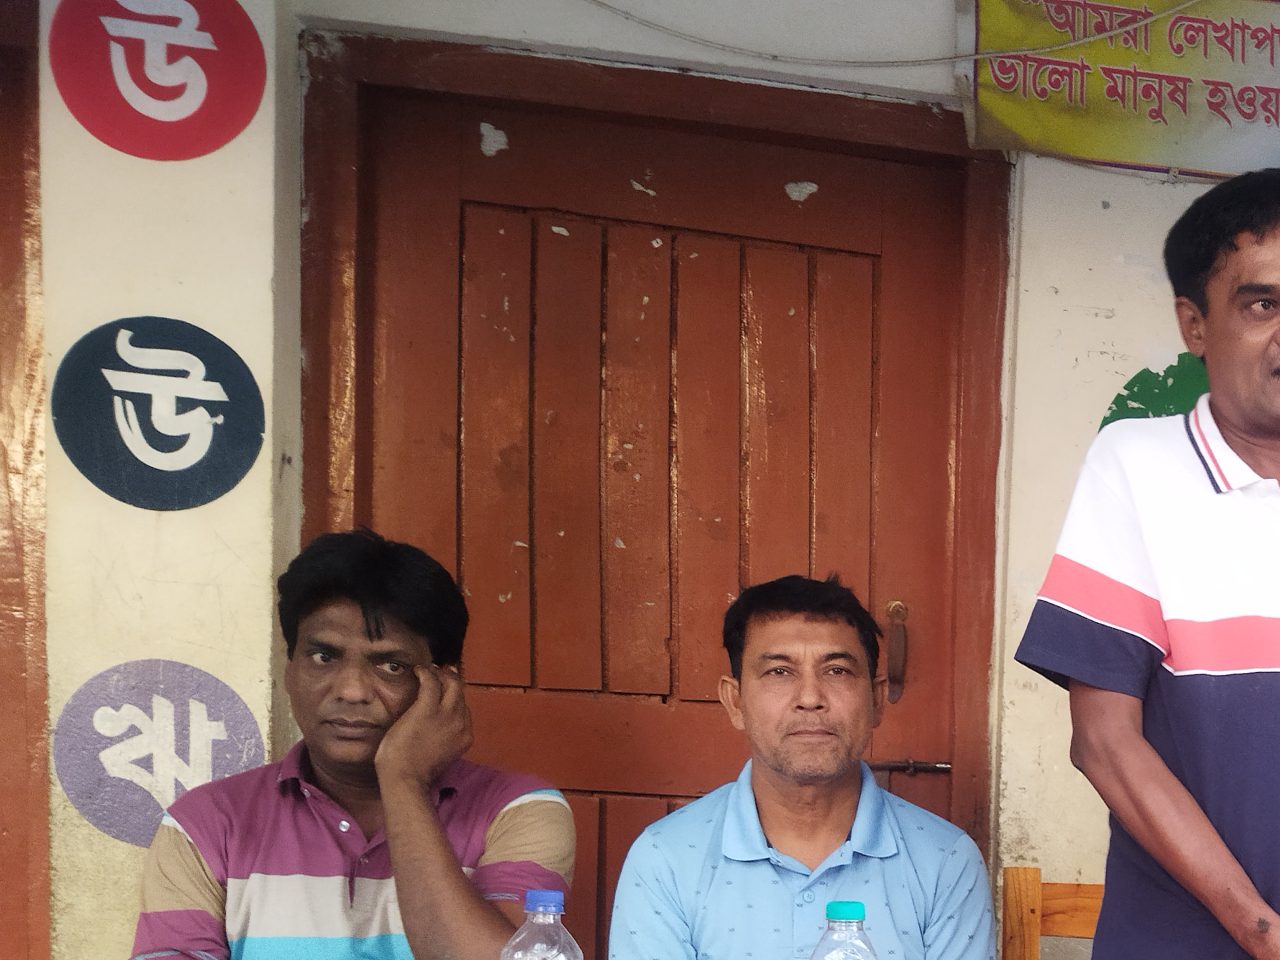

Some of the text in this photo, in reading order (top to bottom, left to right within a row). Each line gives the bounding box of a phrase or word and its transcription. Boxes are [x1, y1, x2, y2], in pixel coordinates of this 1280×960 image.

[100, 0, 218, 121] উ
[989, 54, 1093, 108] ভালো
[1099, 64, 1193, 126] মানুষ
